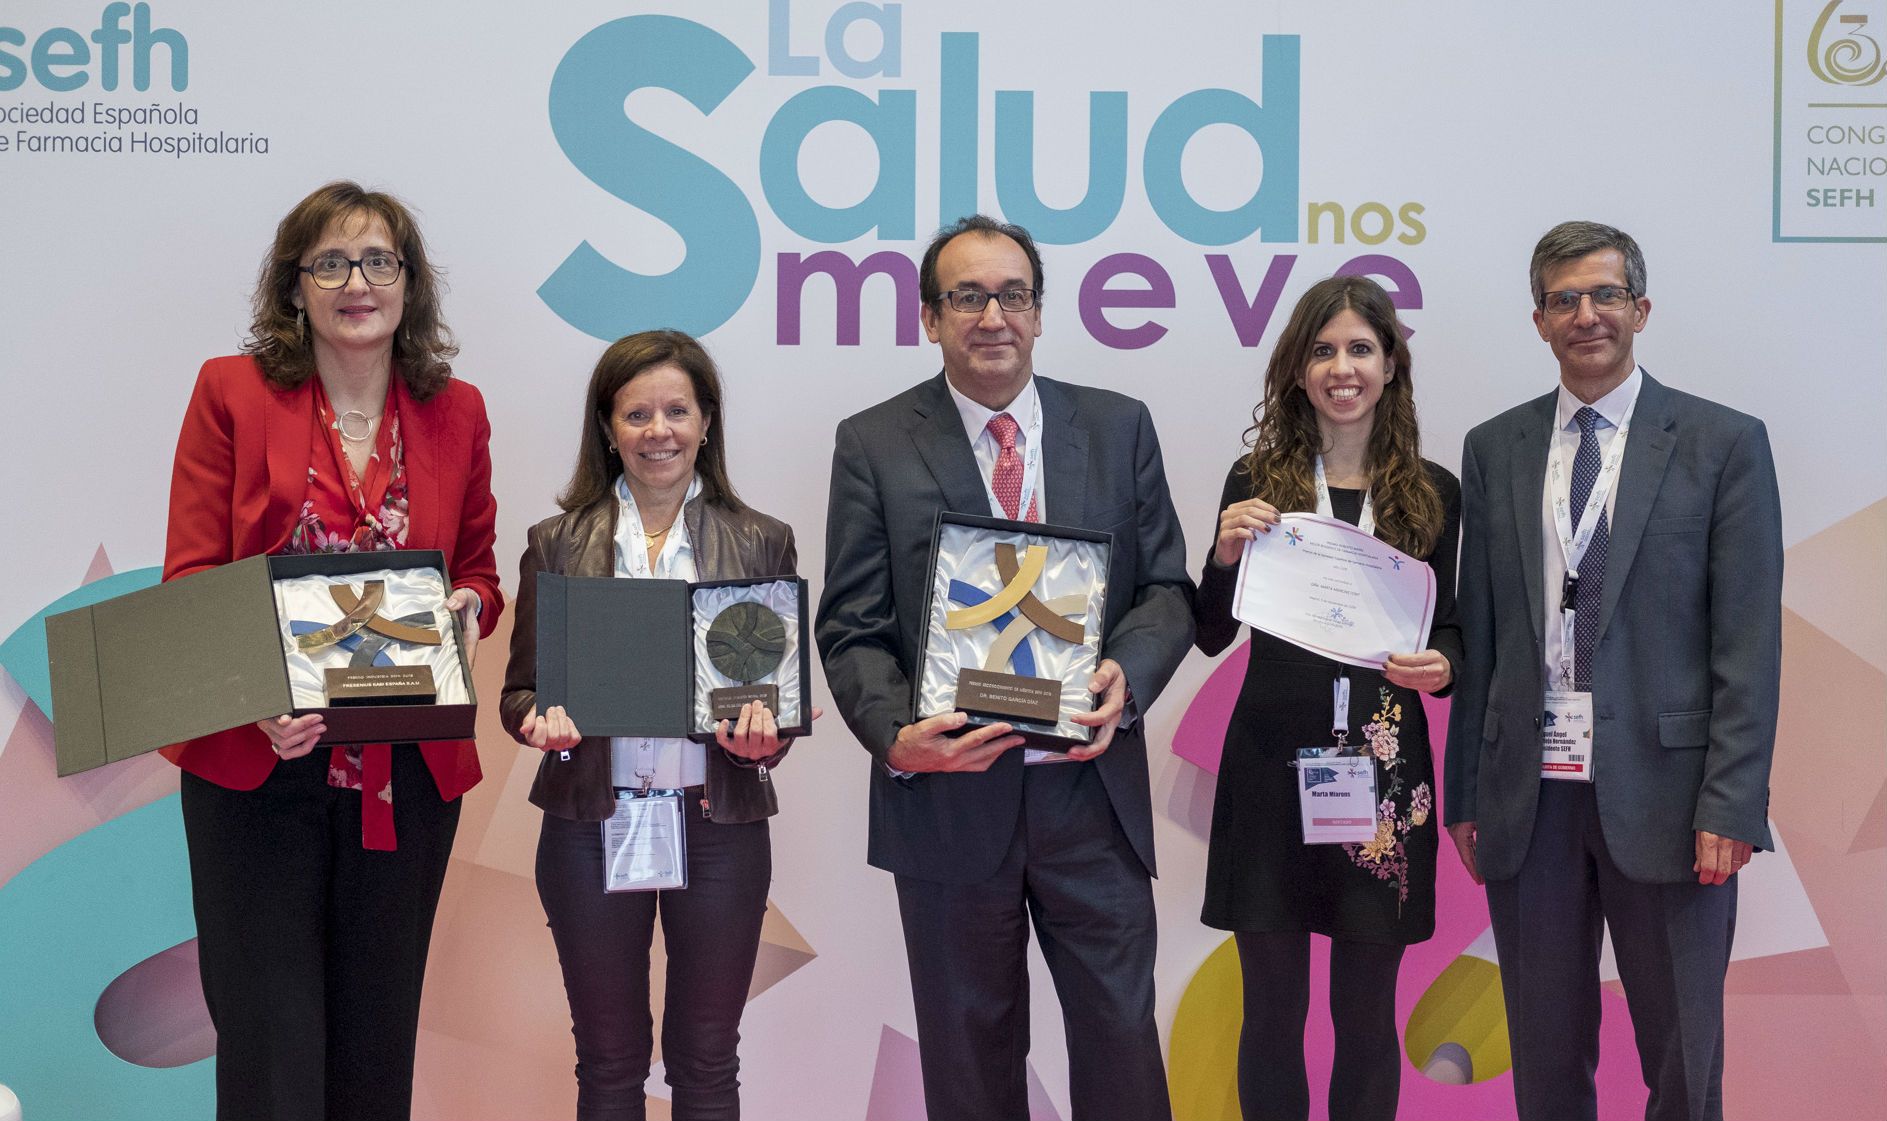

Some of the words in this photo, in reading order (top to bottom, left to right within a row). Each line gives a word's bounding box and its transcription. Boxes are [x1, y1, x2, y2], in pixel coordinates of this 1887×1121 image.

[0, 1, 189, 92] sefh
[768, 0, 902, 79] La
[93, 102, 199, 130] Española
[16, 130, 123, 153] Farmacia
[130, 131, 270, 159] Hospitalaria
[1807, 125, 1885, 145] CONG
[536, 14, 1301, 344] Salud
[1307, 201, 1427, 246] nos
[1807, 157, 1887, 176] NACIO
[1806, 188, 1875, 208] SEFH
[776, 250, 1424, 350] mev
